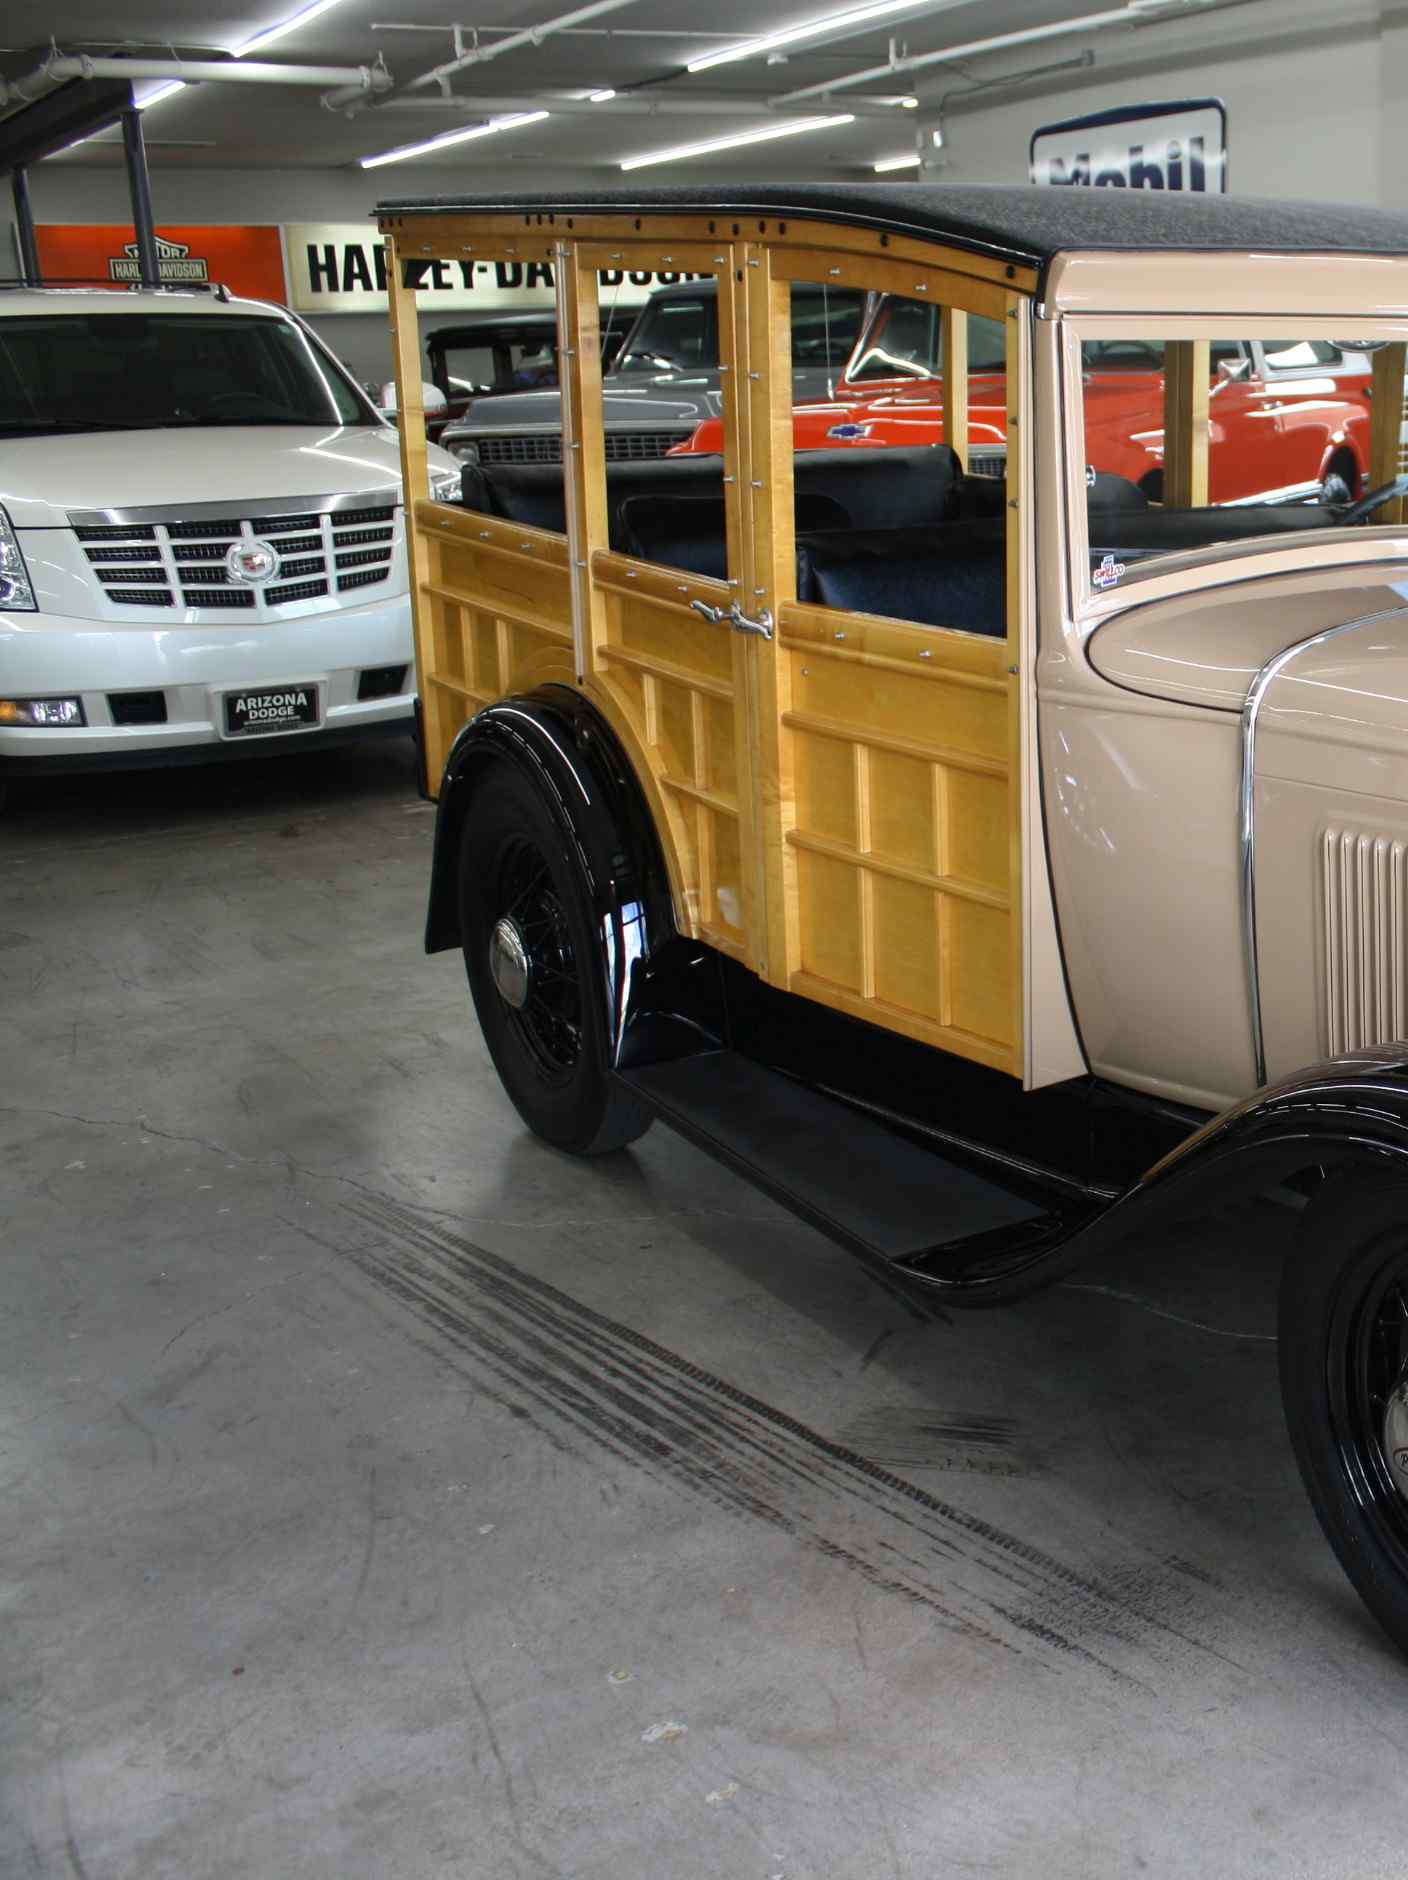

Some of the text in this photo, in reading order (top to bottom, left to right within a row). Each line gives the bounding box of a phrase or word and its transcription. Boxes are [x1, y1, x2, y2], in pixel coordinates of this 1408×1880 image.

[115, 262, 203, 278] HARLAVIDSON
[236, 692, 308, 713] ARIZONA
[249, 705, 295, 720] DODGE
